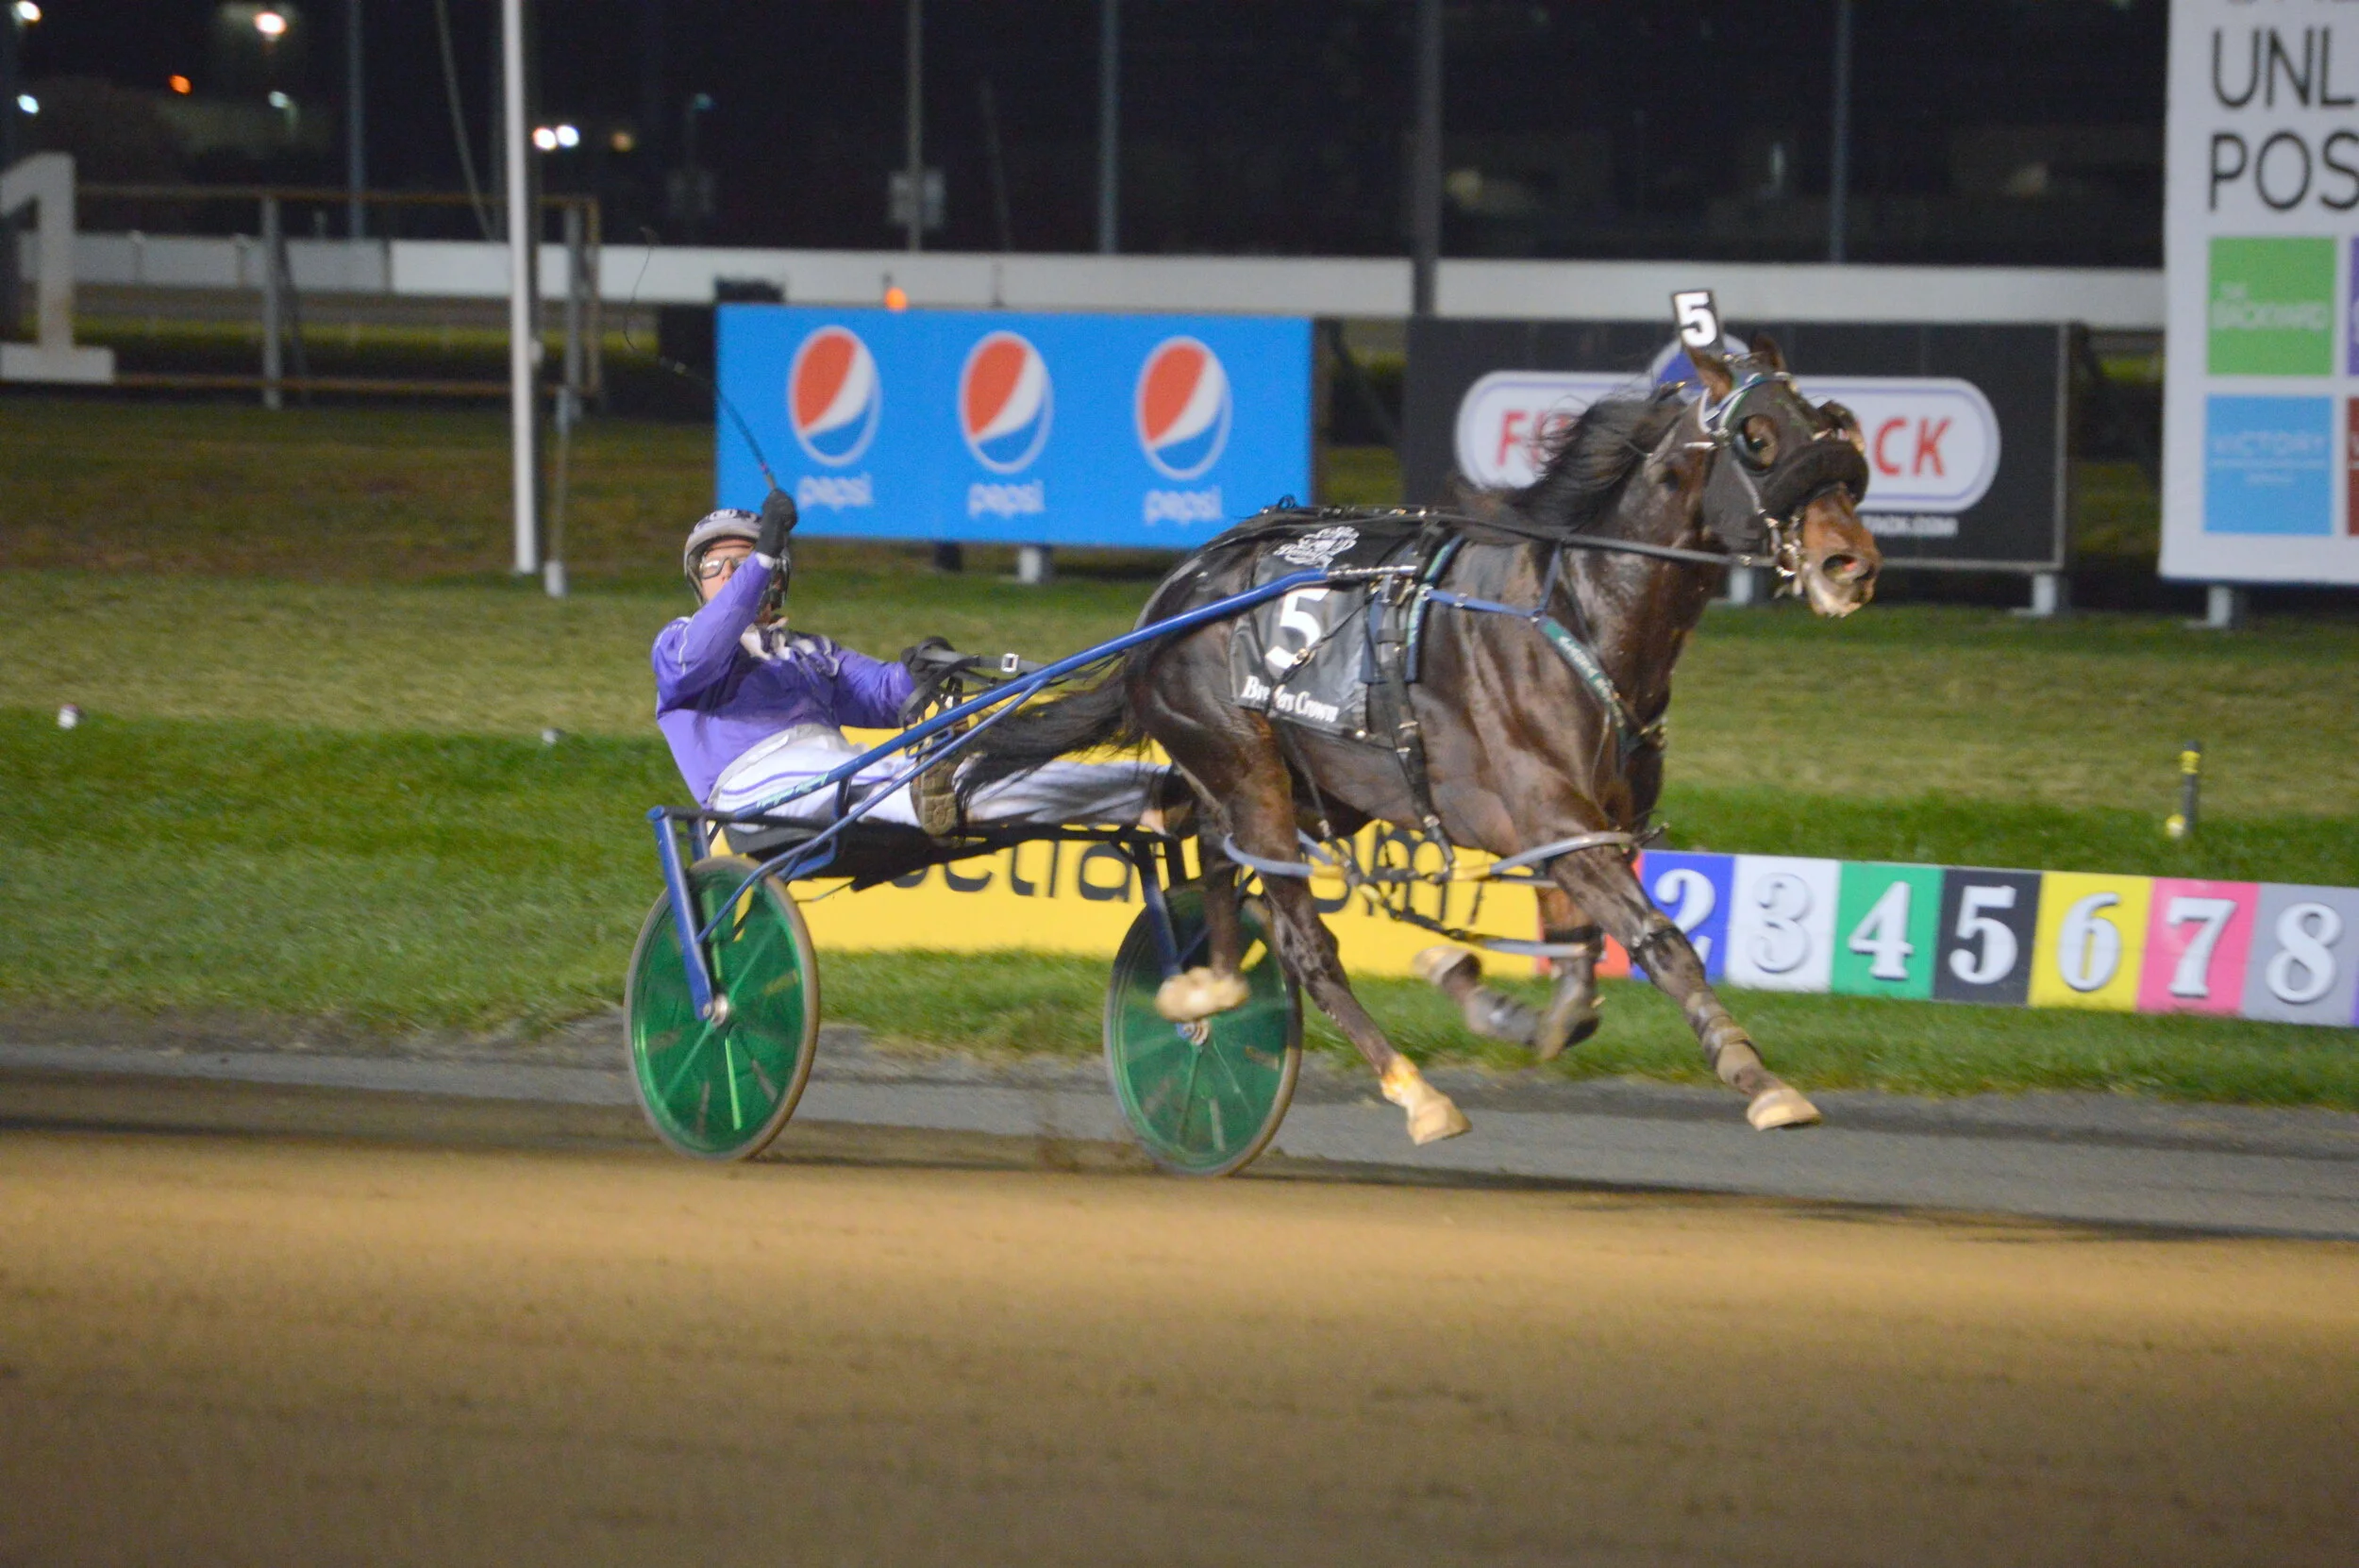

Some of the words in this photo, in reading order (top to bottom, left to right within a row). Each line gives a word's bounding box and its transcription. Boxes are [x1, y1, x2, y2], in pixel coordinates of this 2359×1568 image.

[1674, 292, 1717, 347] 5
[797, 473, 872, 510] pepsi
[968, 479, 1045, 519] pepsi
[1144, 486, 1223, 525] pepsi
[1265, 588, 1330, 669] 5
[1295, 691, 1339, 724] Crown
[1654, 868, 1715, 965] 2
[1750, 872, 1812, 974] 3
[1849, 880, 1914, 979] 4
[1949, 885, 2017, 985] 5
[2058, 891, 2121, 992] 6
[2167, 895, 2238, 998] 7
[2266, 901, 2343, 1004] 8
